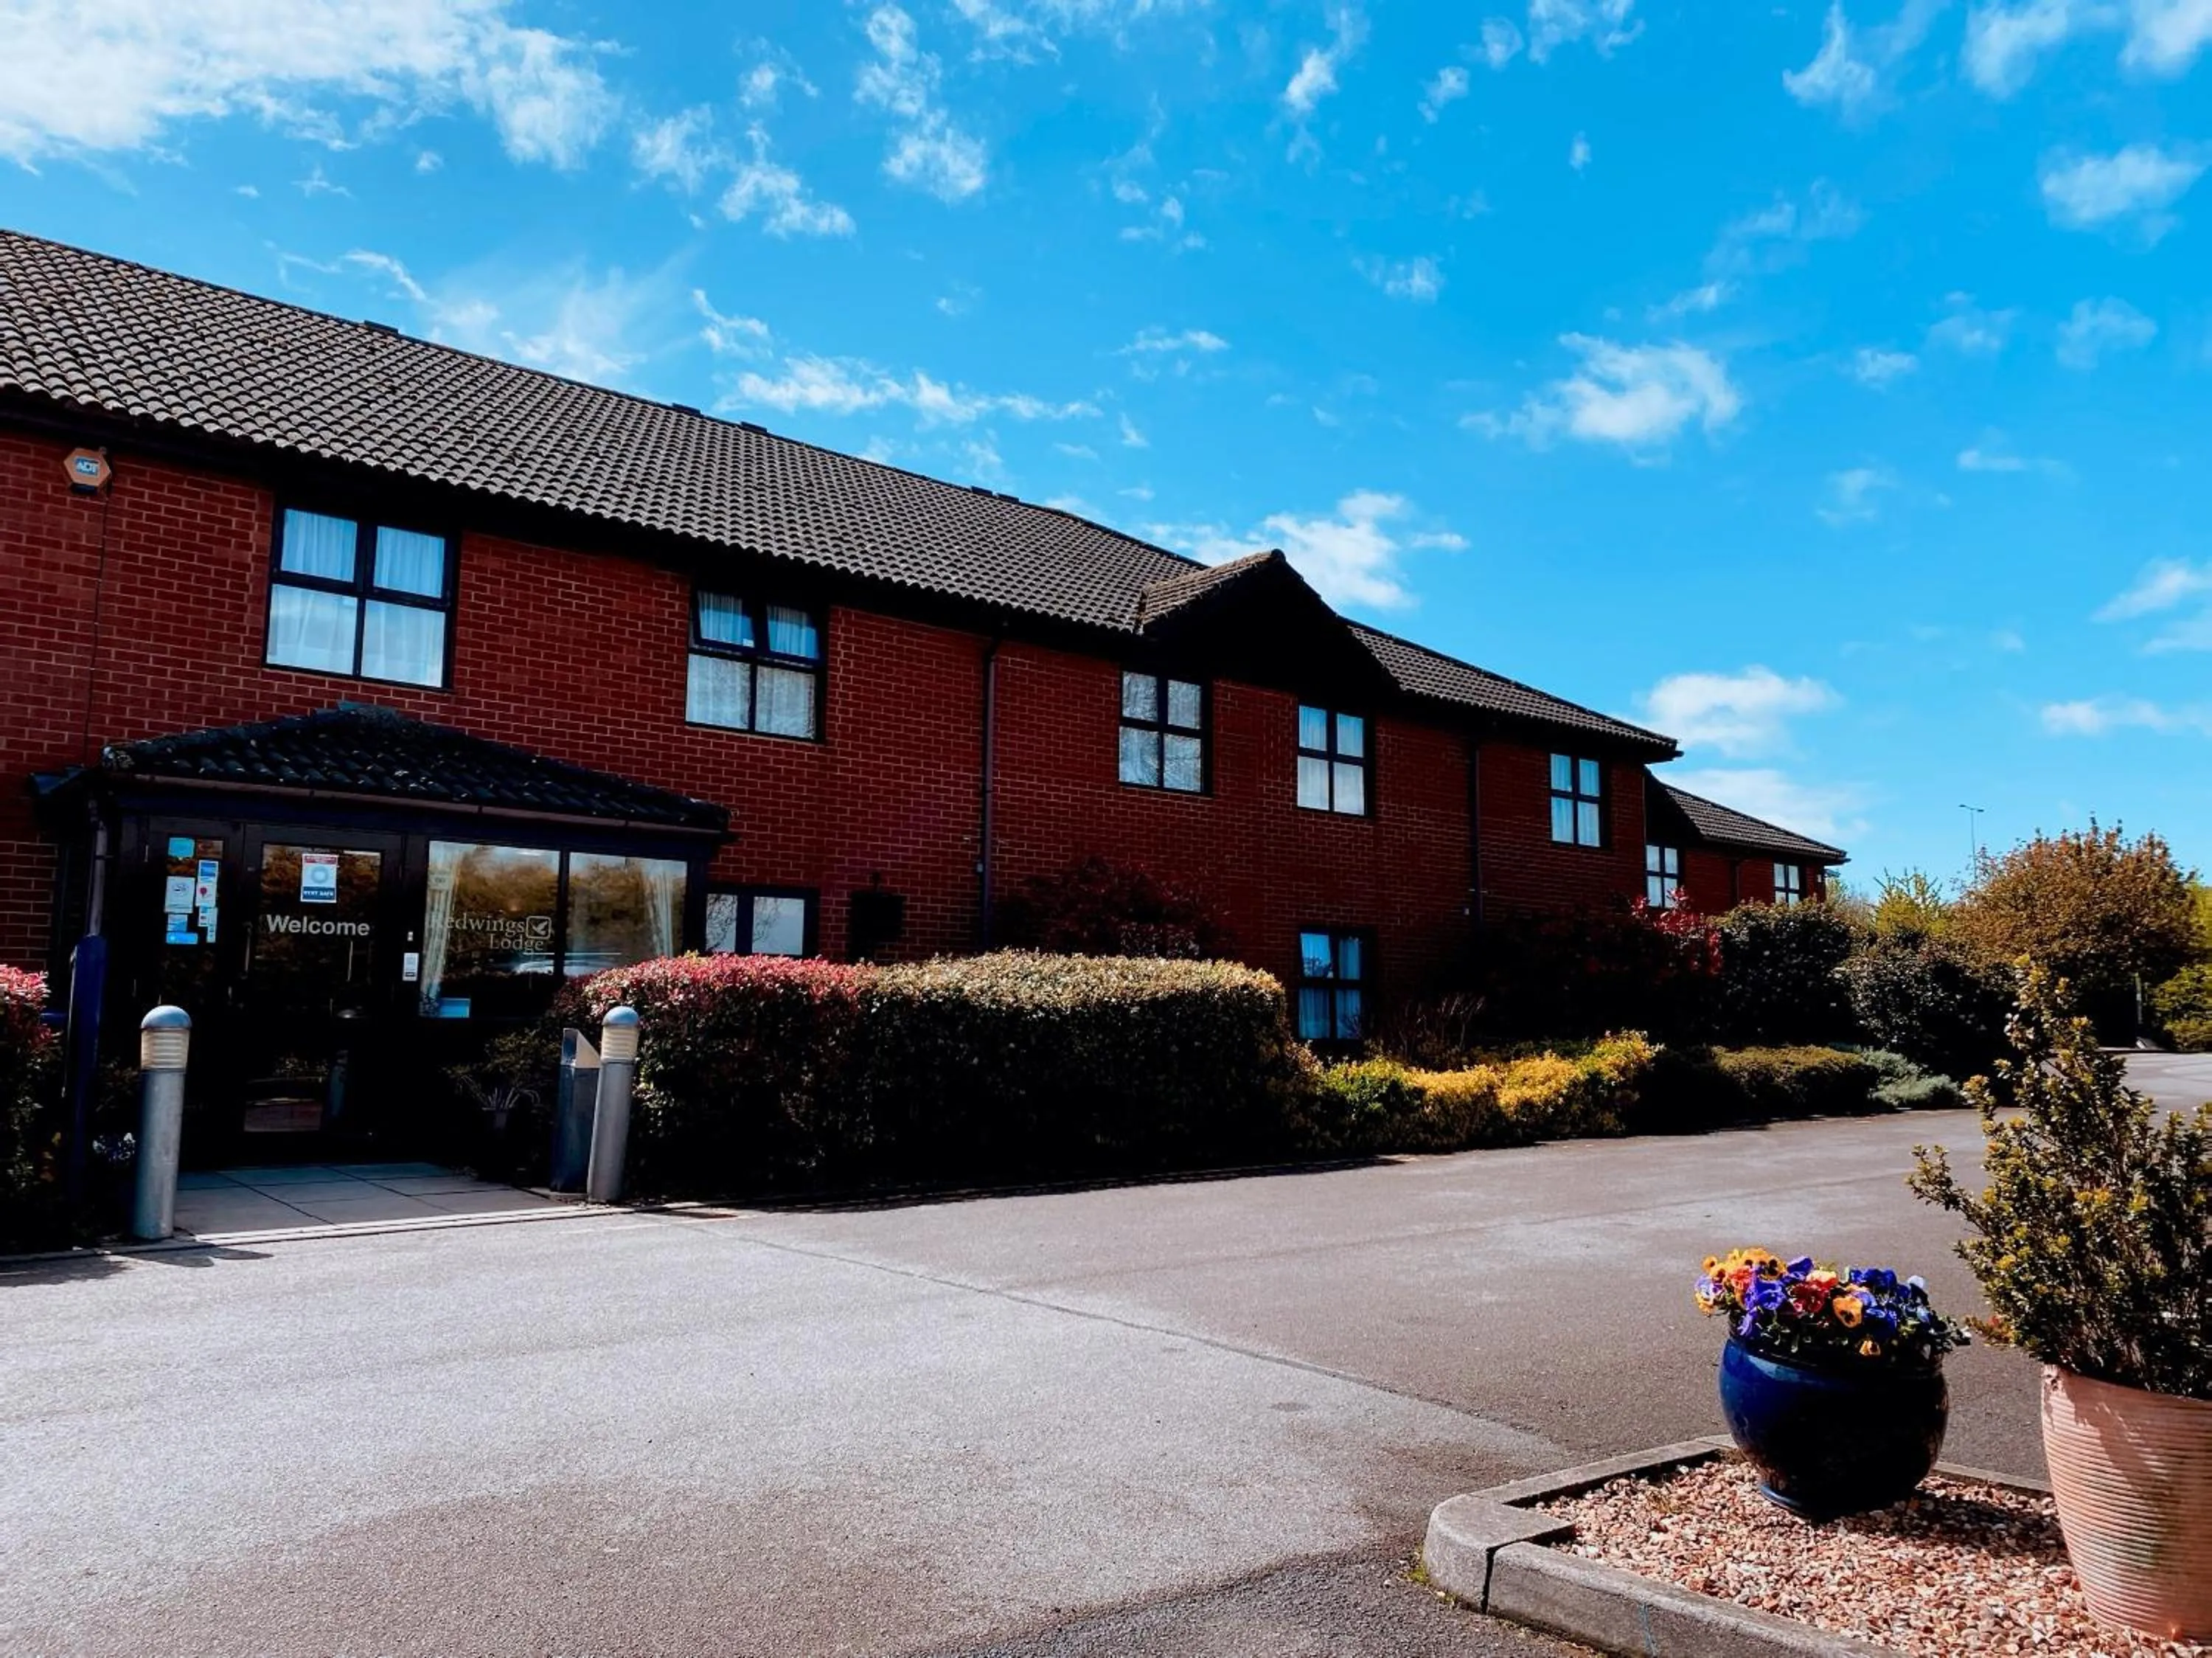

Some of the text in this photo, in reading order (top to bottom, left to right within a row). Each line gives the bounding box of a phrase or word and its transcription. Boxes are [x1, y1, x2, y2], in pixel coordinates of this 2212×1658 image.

[76, 461, 98, 474] ADT
[266, 914, 370, 936] Welcome
[490, 933, 544, 954] Lodge
